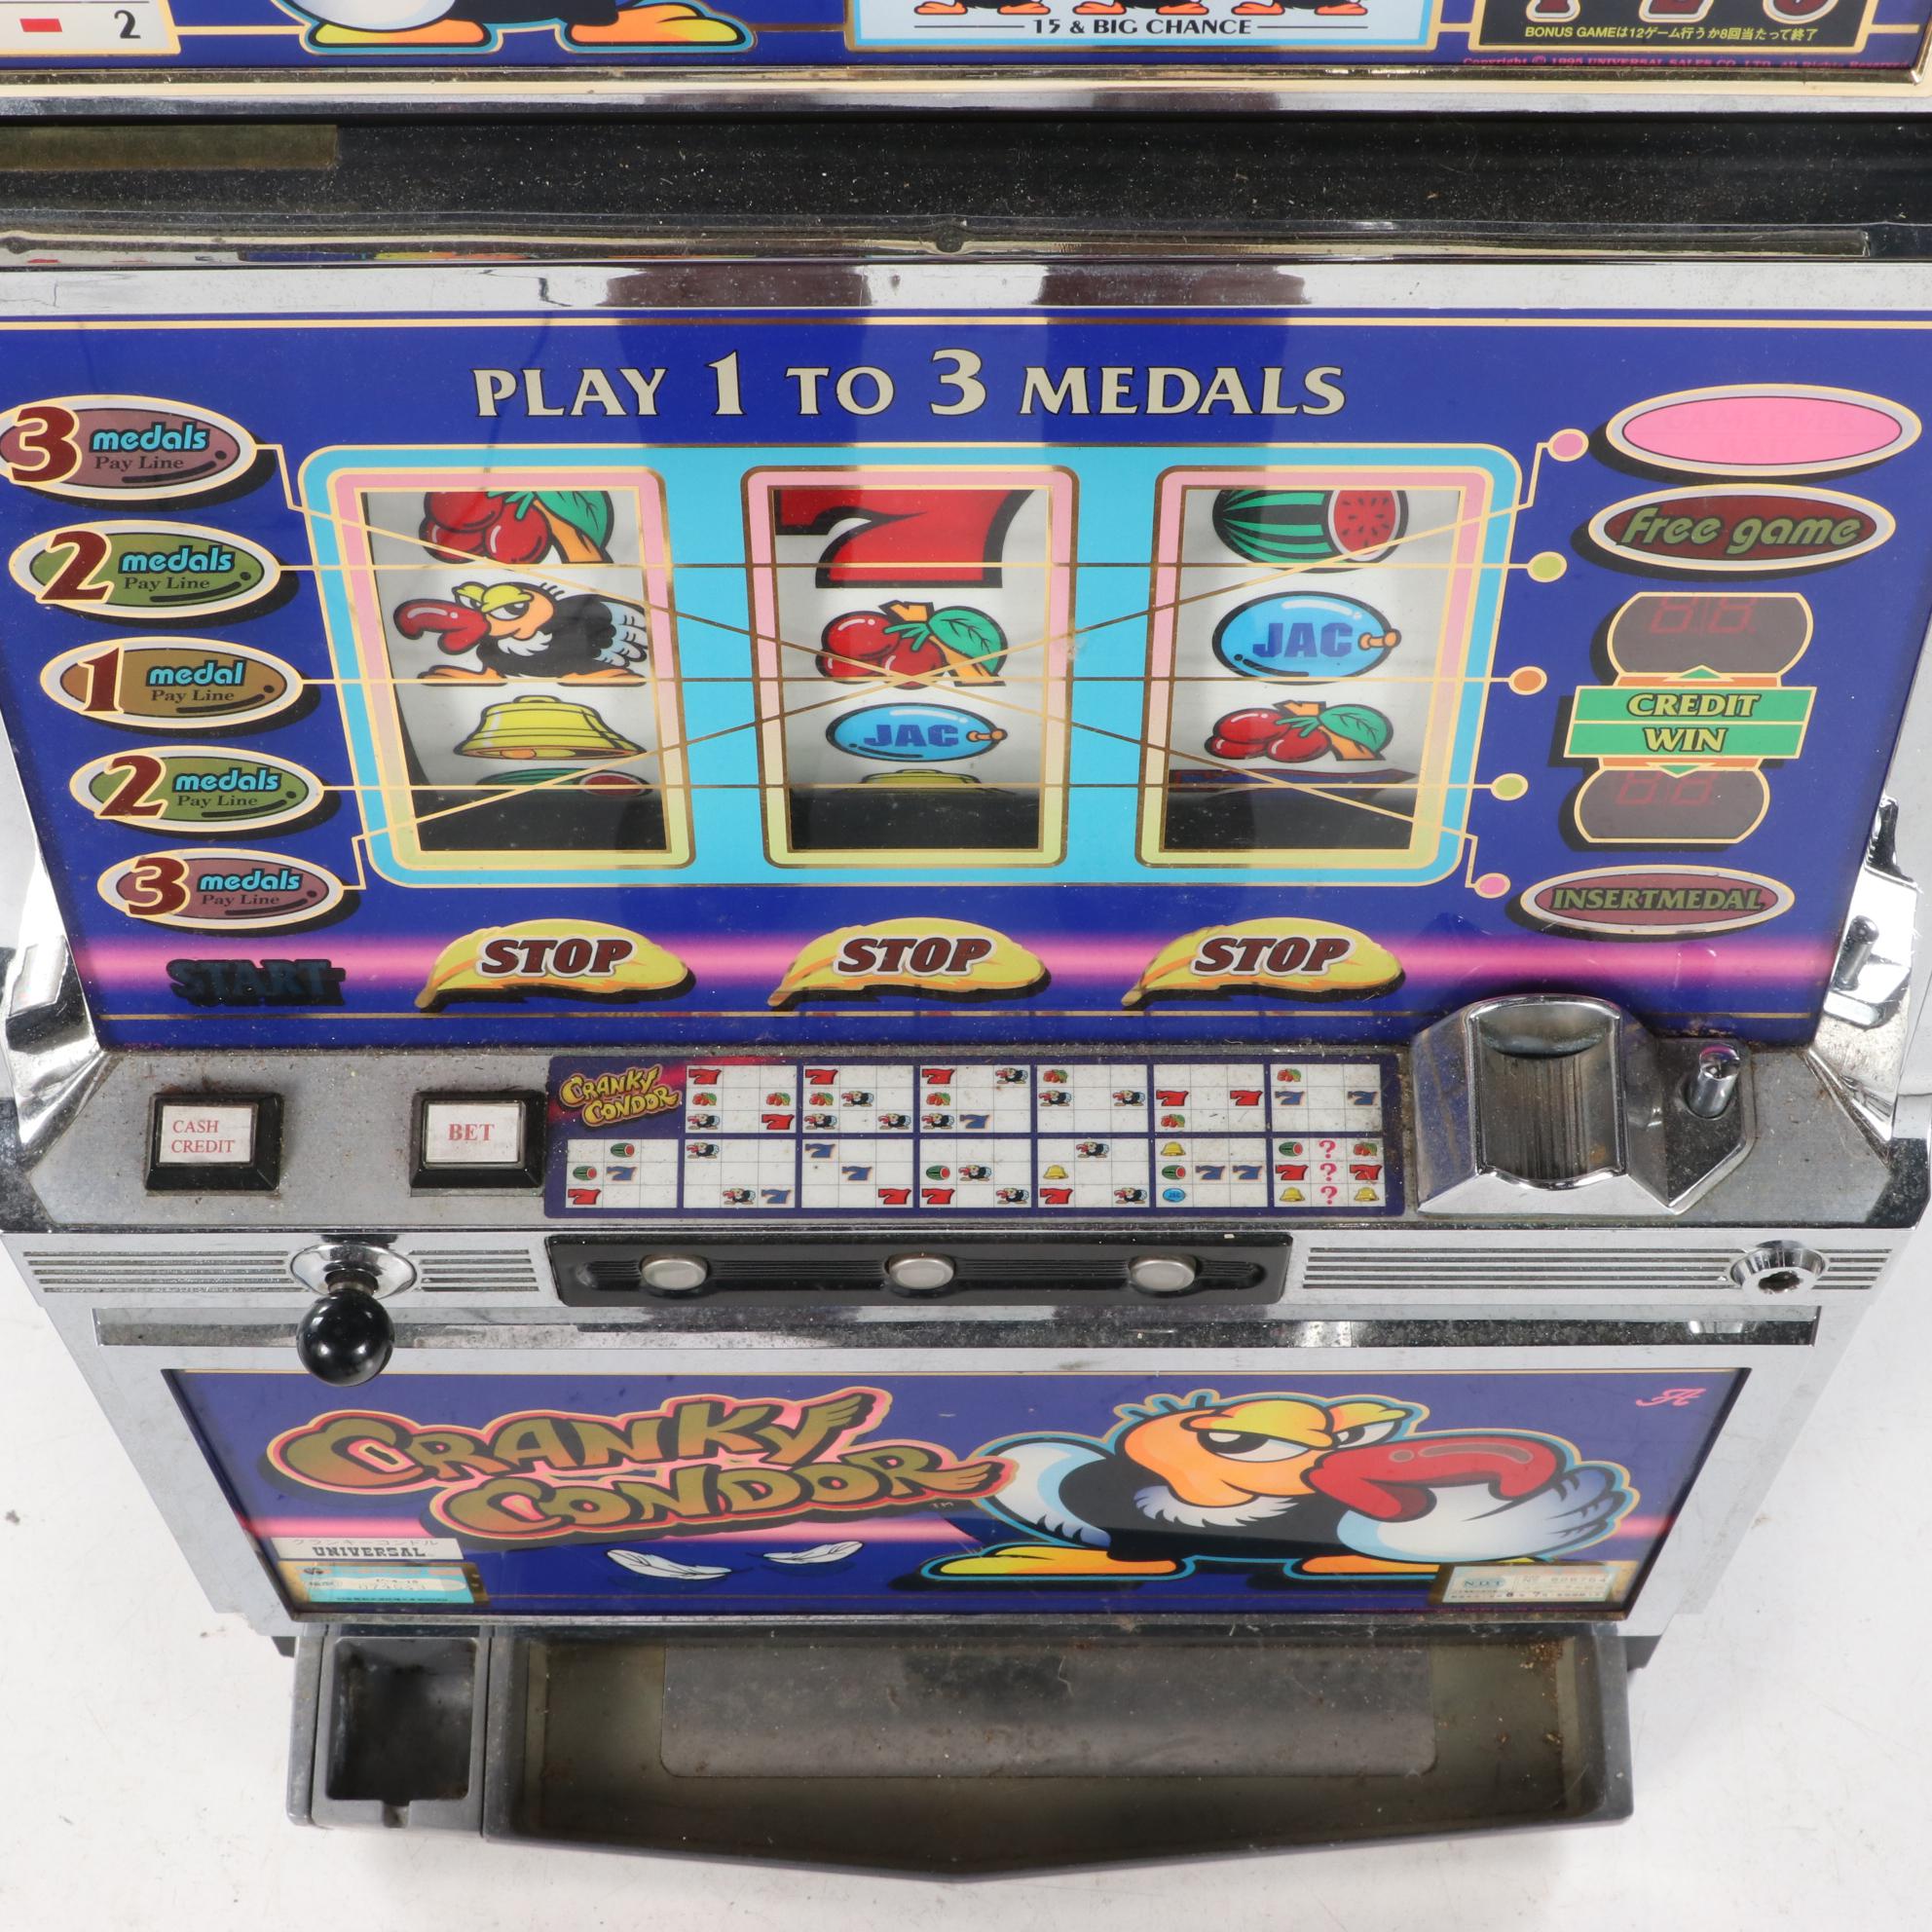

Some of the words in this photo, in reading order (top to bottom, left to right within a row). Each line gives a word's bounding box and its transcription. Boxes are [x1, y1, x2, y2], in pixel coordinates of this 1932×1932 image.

[113, 10, 141, 39] 2
[1034, 19, 1060, 34] 15
[1093, 19, 1137, 34] BIG
[1145, 19, 1251, 34] CHANCE
[1525, 26, 1573, 38] BONUS
[472, 368, 669, 419] PLAY
[708, 349, 744, 418] 1
[785, 366, 896, 419] TO
[929, 348, 988, 418] 3
[1020, 366, 1347, 419] MEDALS
[11, 404, 78, 483] 3
[90, 421, 210, 453] medals
[95, 457, 134, 472] Pay
[138, 457, 184, 469] Line
[1616, 506, 1723, 545] Free
[1726, 517, 1863, 555] game
[40, 530, 110, 601] 2
[118, 545, 236, 575] medals
[124, 577, 165, 592] Pay
[167, 576, 210, 590] Line
[1252, 621, 1354, 658] JAC
[80, 646, 122, 713] 1
[146, 658, 247, 687] medal
[150, 689, 190, 704] Pay
[193, 689, 235, 702] Line
[1627, 692, 1762, 718] CREDIT
[863, 724, 959, 748] JAC
[1643, 726, 1728, 753] WIN
[99, 754, 165, 818] 2
[172, 766, 282, 793] medals
[176, 795, 215, 808] Pay
[217, 795, 258, 807] Line
[129, 856, 189, 916] 3
[197, 868, 304, 893] medals
[201, 894, 239, 907] Pay
[241, 894, 280, 906] Line
[481, 938, 633, 974] STOP
[837, 937, 992, 973] STOP
[1194, 937, 1351, 973] STOP
[167, 959, 339, 1004] START
[560, 1065, 661, 1108] CRANKY
[583, 1085, 680, 1127] CONDOR
[172, 1120, 219, 1134] CASH
[448, 1124, 495, 1142] BET
[170, 1139, 235, 1154] CREDIT
[280, 1392, 876, 1488] CRANKY
[442, 1445, 1002, 1534] CONDOR
[312, 1546, 427, 1557] UNIVERSAL
